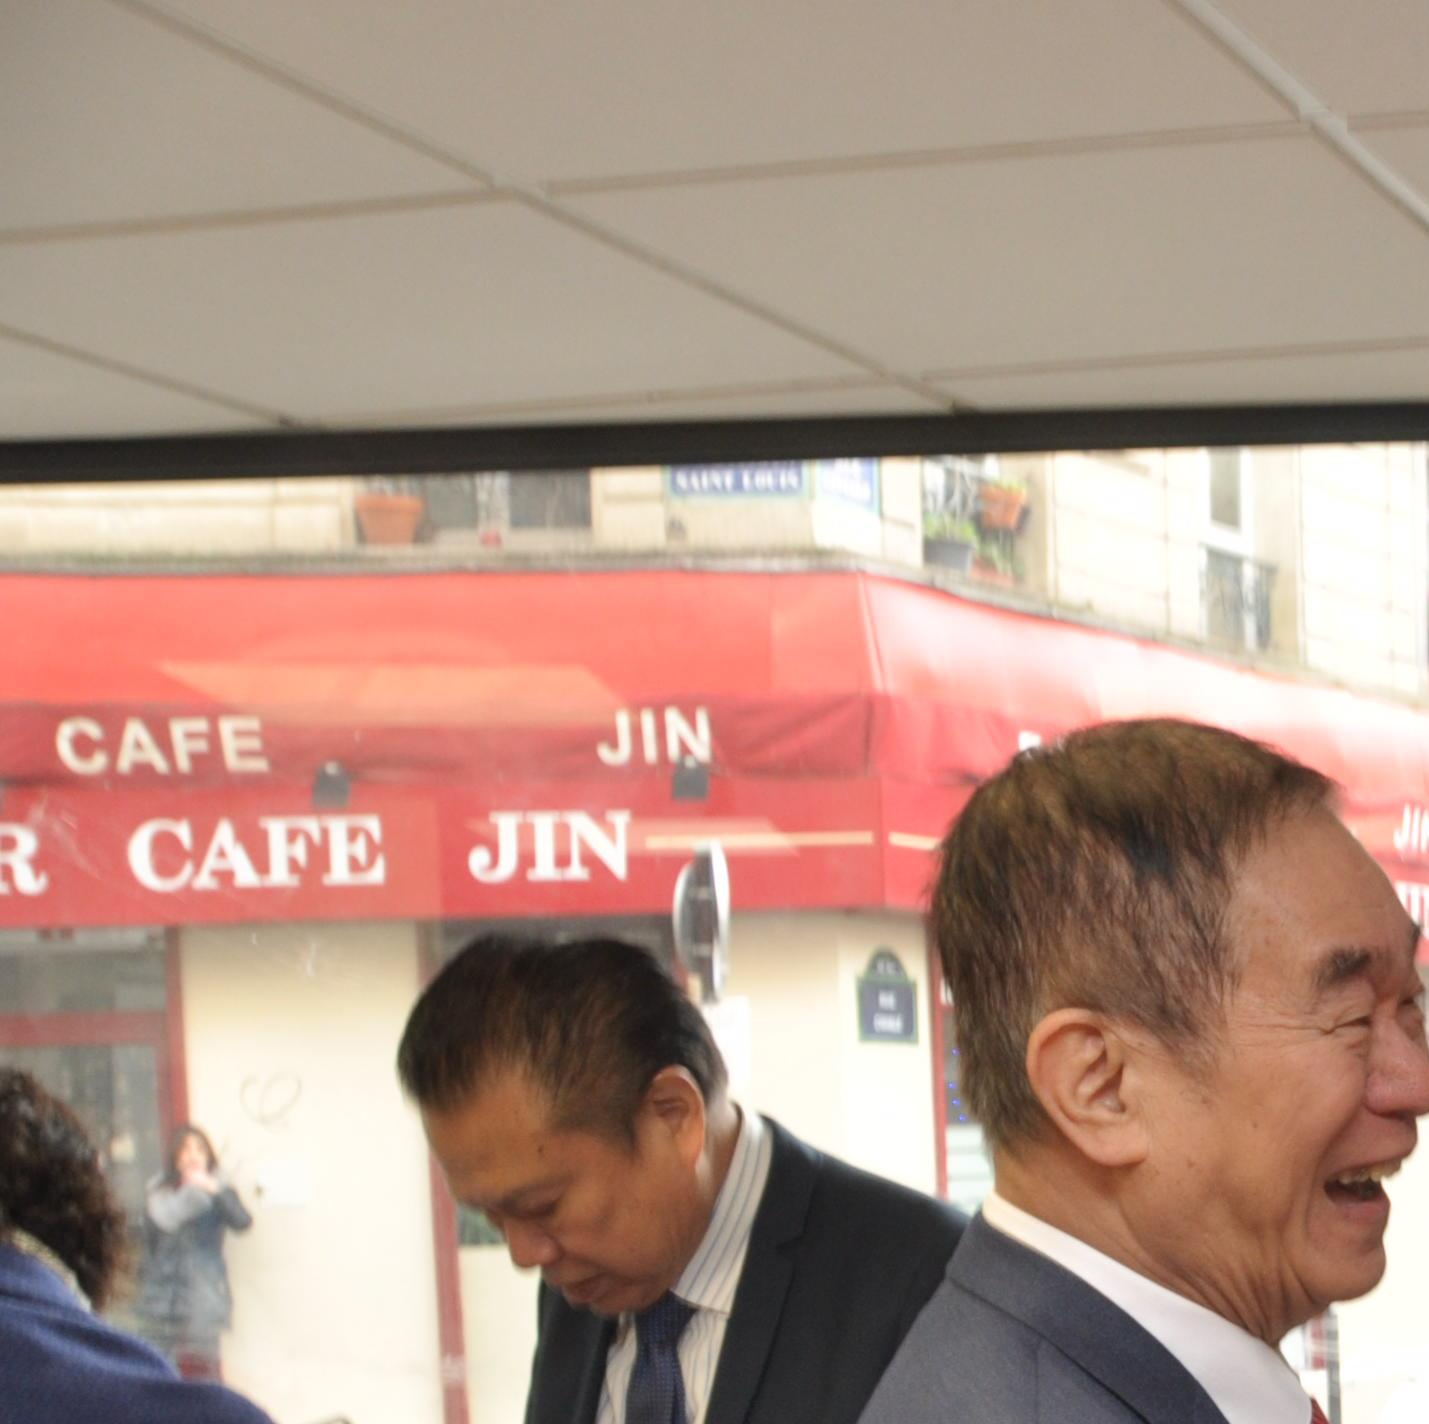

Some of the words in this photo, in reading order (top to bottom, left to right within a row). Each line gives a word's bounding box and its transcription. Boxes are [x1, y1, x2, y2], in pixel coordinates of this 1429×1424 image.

[55, 715, 271, 775] CAFE
[596, 706, 711, 766] JIN
[127, 814, 386, 892] CAFE
[468, 810, 632, 883] JIN
